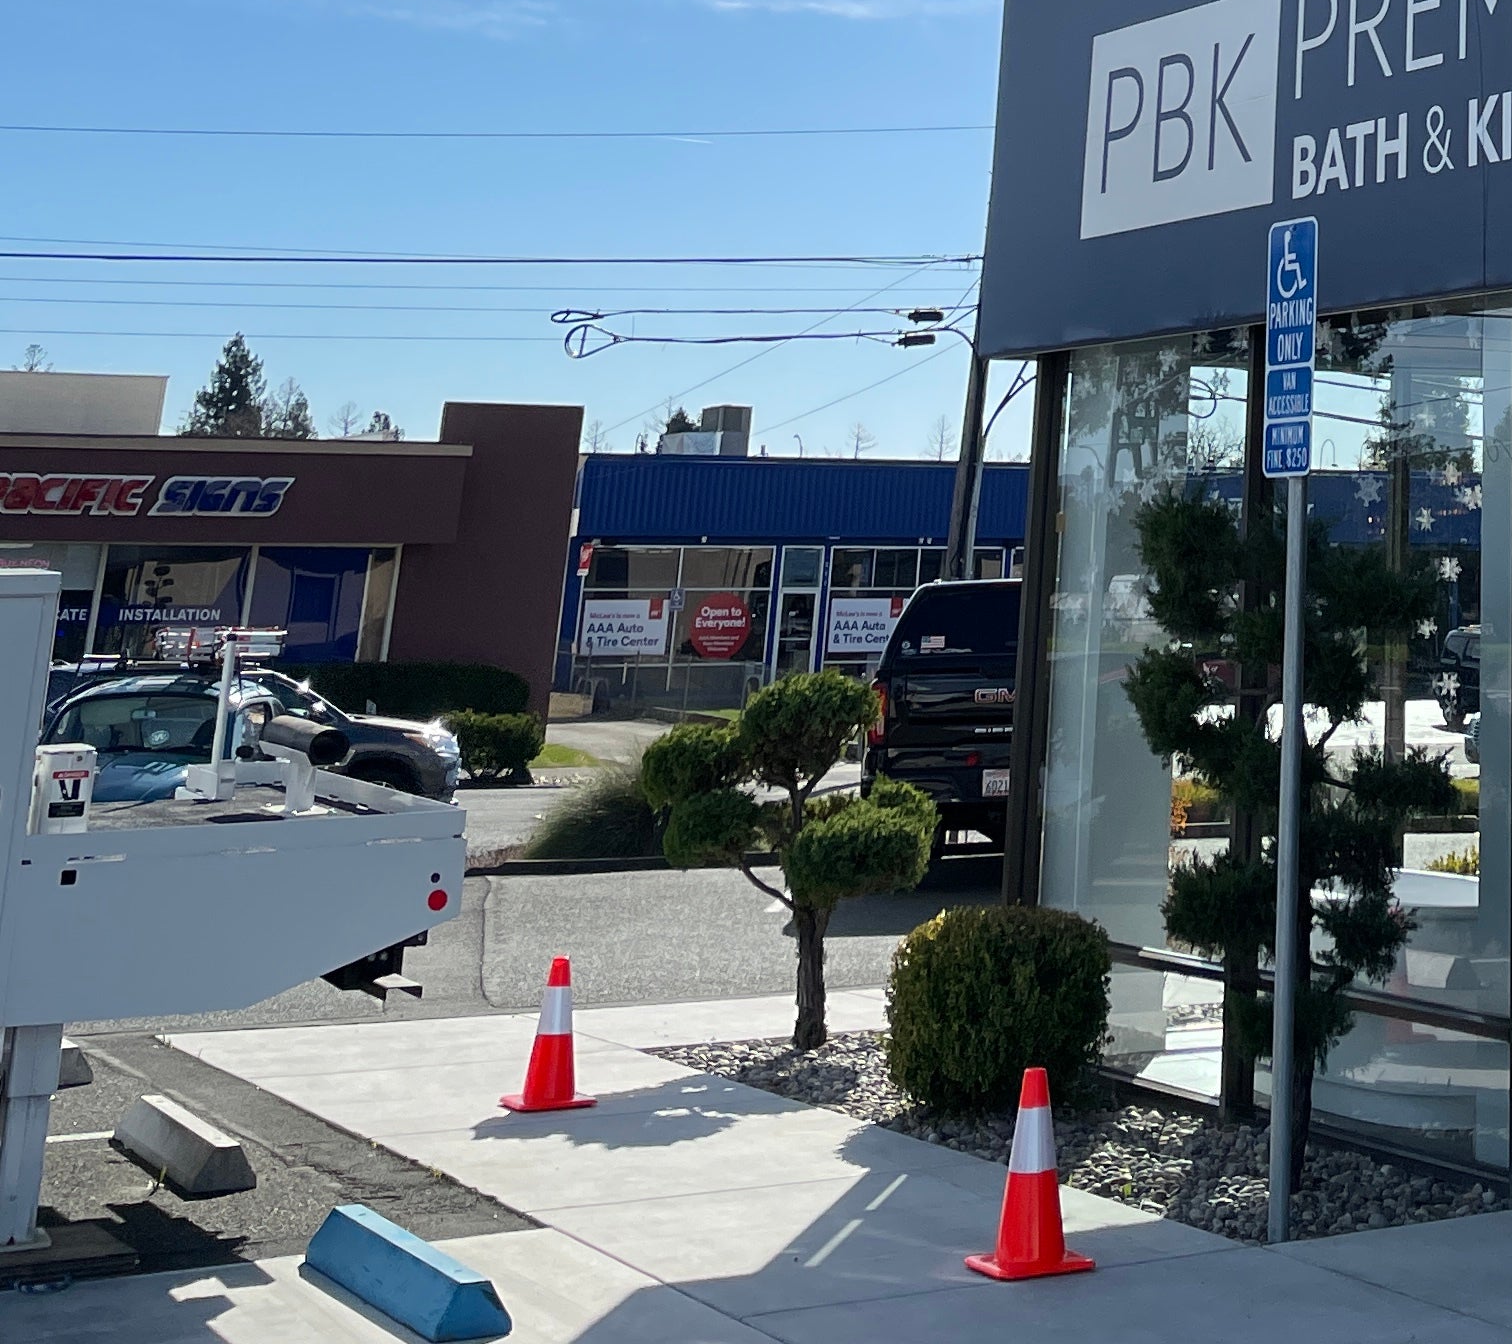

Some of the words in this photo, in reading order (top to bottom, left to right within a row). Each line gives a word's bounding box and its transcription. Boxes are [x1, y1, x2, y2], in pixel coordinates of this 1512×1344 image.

[1100, 33, 1255, 194] PBK
[1292, 112, 1408, 201] BATH
[1422, 104, 1455, 175] &
[1269, 297, 1313, 330] PARKING
[1277, 331, 1304, 362] ONLY
[1282, 371, 1297, 391] VAN
[1267, 393, 1310, 416] ACCESSIBLE
[1271, 425, 1304, 446] MINIMUM
[1266, 448, 1283, 470] FINE
[1286, 446, 1308, 468] $250
[118, 608, 221, 621] INSTALLATION
[701, 606, 729, 619] Open
[731, 607, 742, 616] to
[587, 622, 614, 633] AAA
[617, 622, 644, 633] Auto
[695, 616, 746, 630] Everyone!
[834, 620, 859, 631] AAA
[861, 620, 886, 631] Auto
[597, 636, 618, 647] Tire
[621, 635, 659, 647] Center
[833, 633, 840, 644] &
[843, 633, 863, 644] Tire
[865, 633, 890, 644] Cent
[974, 688, 1016, 703] GM
